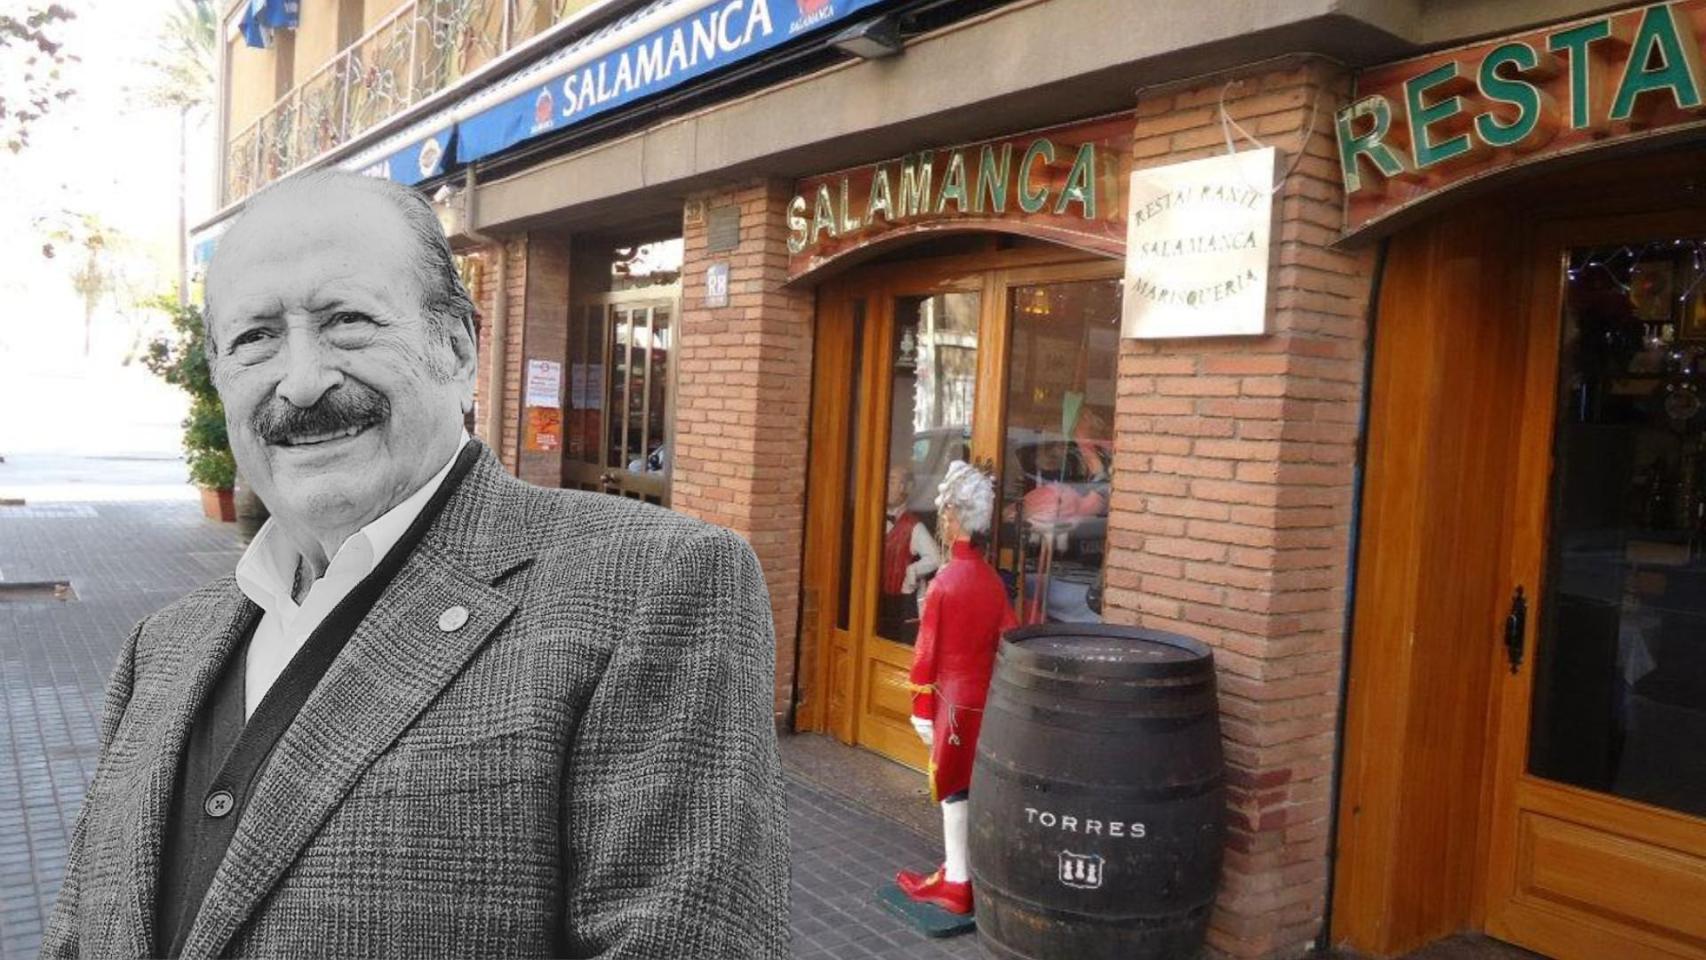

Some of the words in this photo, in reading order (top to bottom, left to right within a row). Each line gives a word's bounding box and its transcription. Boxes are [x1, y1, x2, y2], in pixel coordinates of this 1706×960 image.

[562, 0, 774, 117] SALAMANCA
[1335, 2, 1702, 193] RESTA
[786, 138, 1096, 254] SALAMANCA
[1140, 230, 1257, 259] SALAMANCA
[1025, 807, 1146, 838] TORRES
